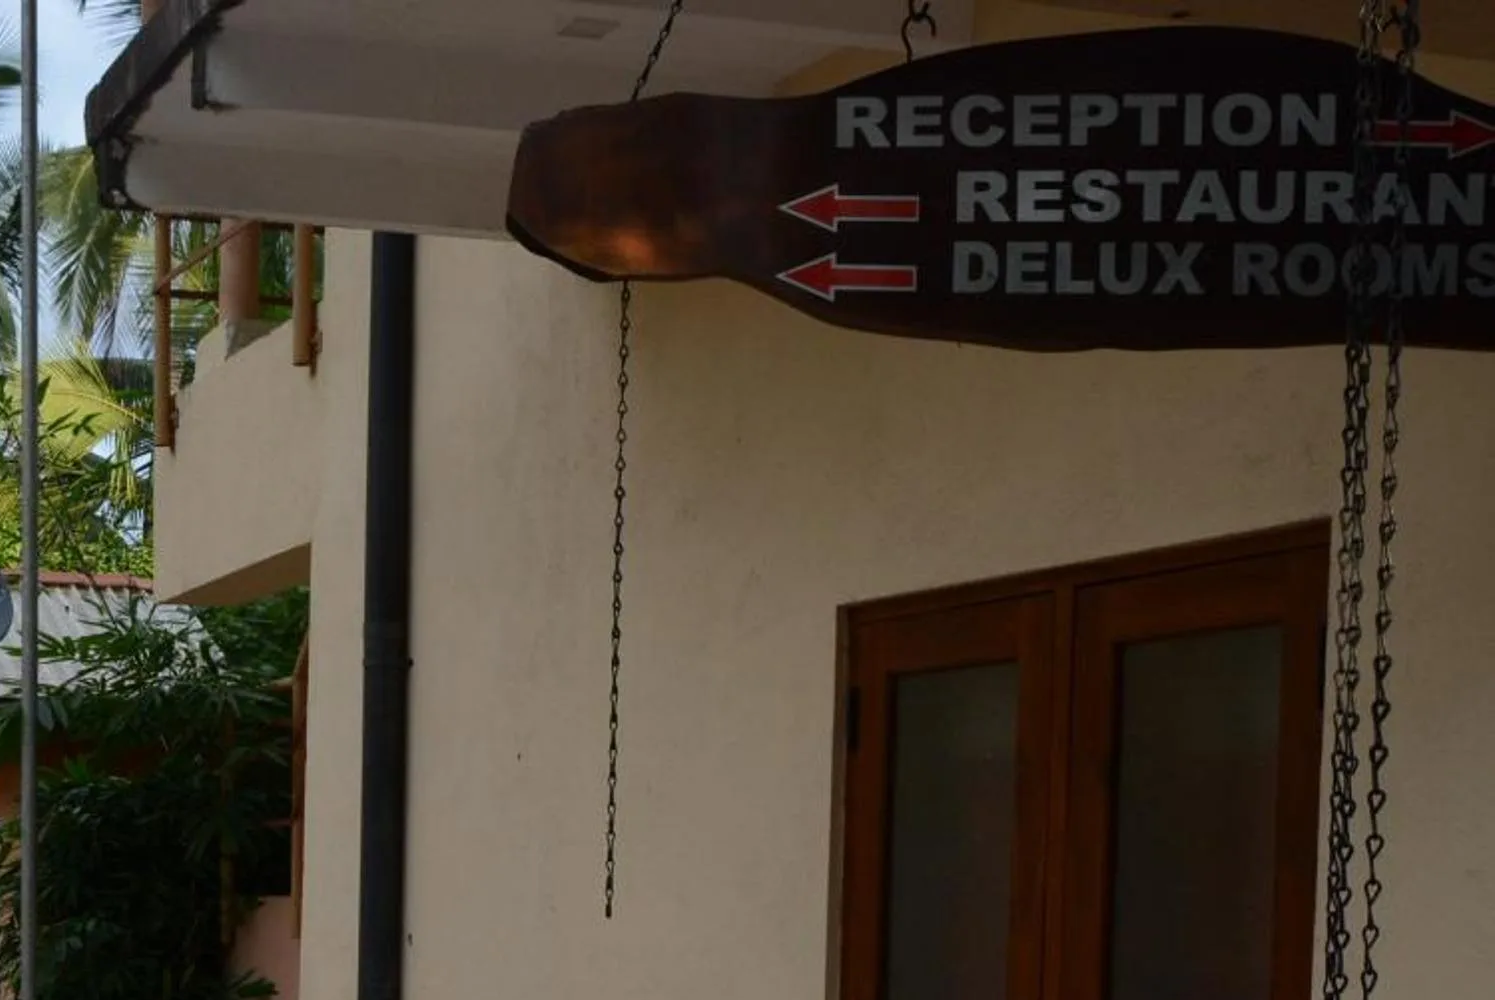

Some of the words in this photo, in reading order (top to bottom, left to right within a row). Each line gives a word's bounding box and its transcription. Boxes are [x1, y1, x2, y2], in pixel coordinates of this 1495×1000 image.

[834, 92, 1338, 148] RECEPTION
[956, 168, 1495, 226] RESTAURAN
[951, 240, 1206, 296] DELUX
[1232, 240, 1495, 298] ROOMS
